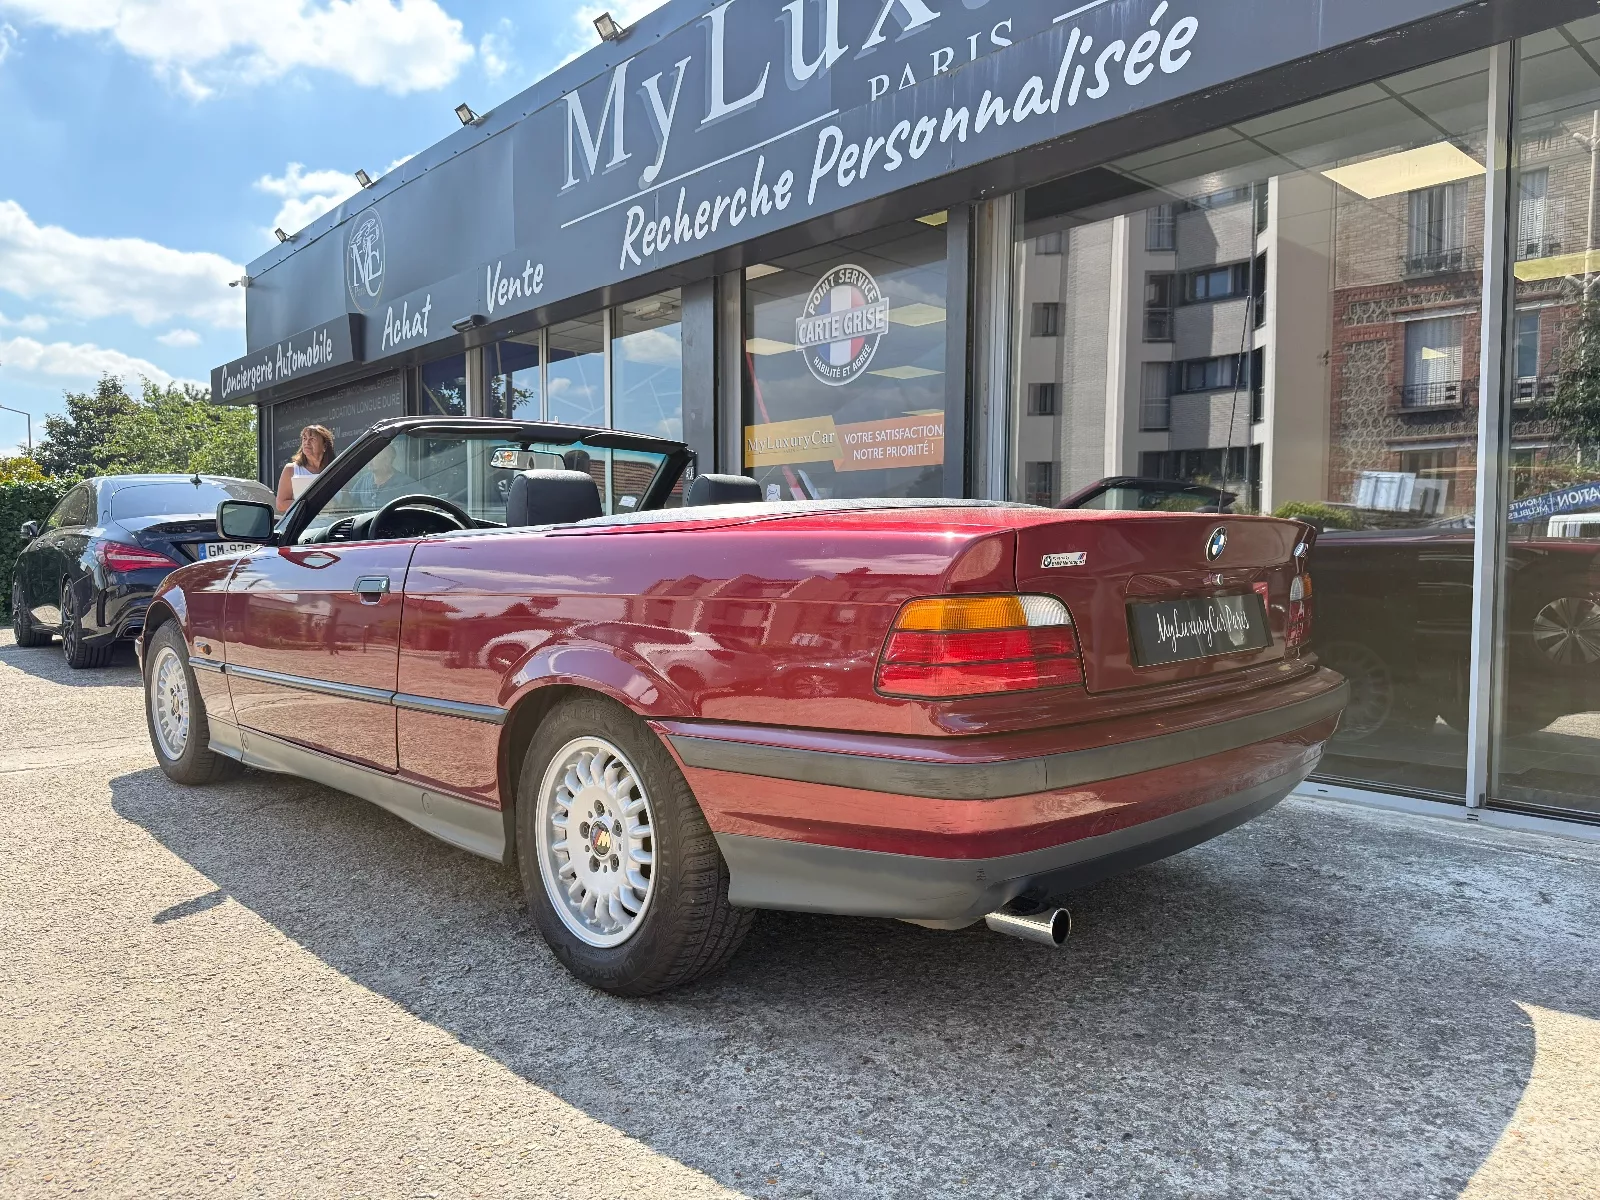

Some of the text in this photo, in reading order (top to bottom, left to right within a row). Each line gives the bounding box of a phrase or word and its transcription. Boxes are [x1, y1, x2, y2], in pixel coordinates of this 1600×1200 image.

[619, 0, 1199, 271] Recherche Personnalisée
[487, 260, 545, 314] Vente
[808, 269, 878, 316] POINT SERVICE
[381, 294, 432, 351] Achat
[798, 304, 886, 344] CARTE GRISE
[221, 328, 333, 399] Conciergerie Automobile
[813, 355, 841, 378] HABILITÉ
[842, 365, 851, 377] ET
[747, 430, 835, 454] MyLuxuryCar
[844, 431, 873, 445] VOTRE
[853, 447, 884, 461] NOTRE
[886, 439, 929, 458] PRIORITÉ
